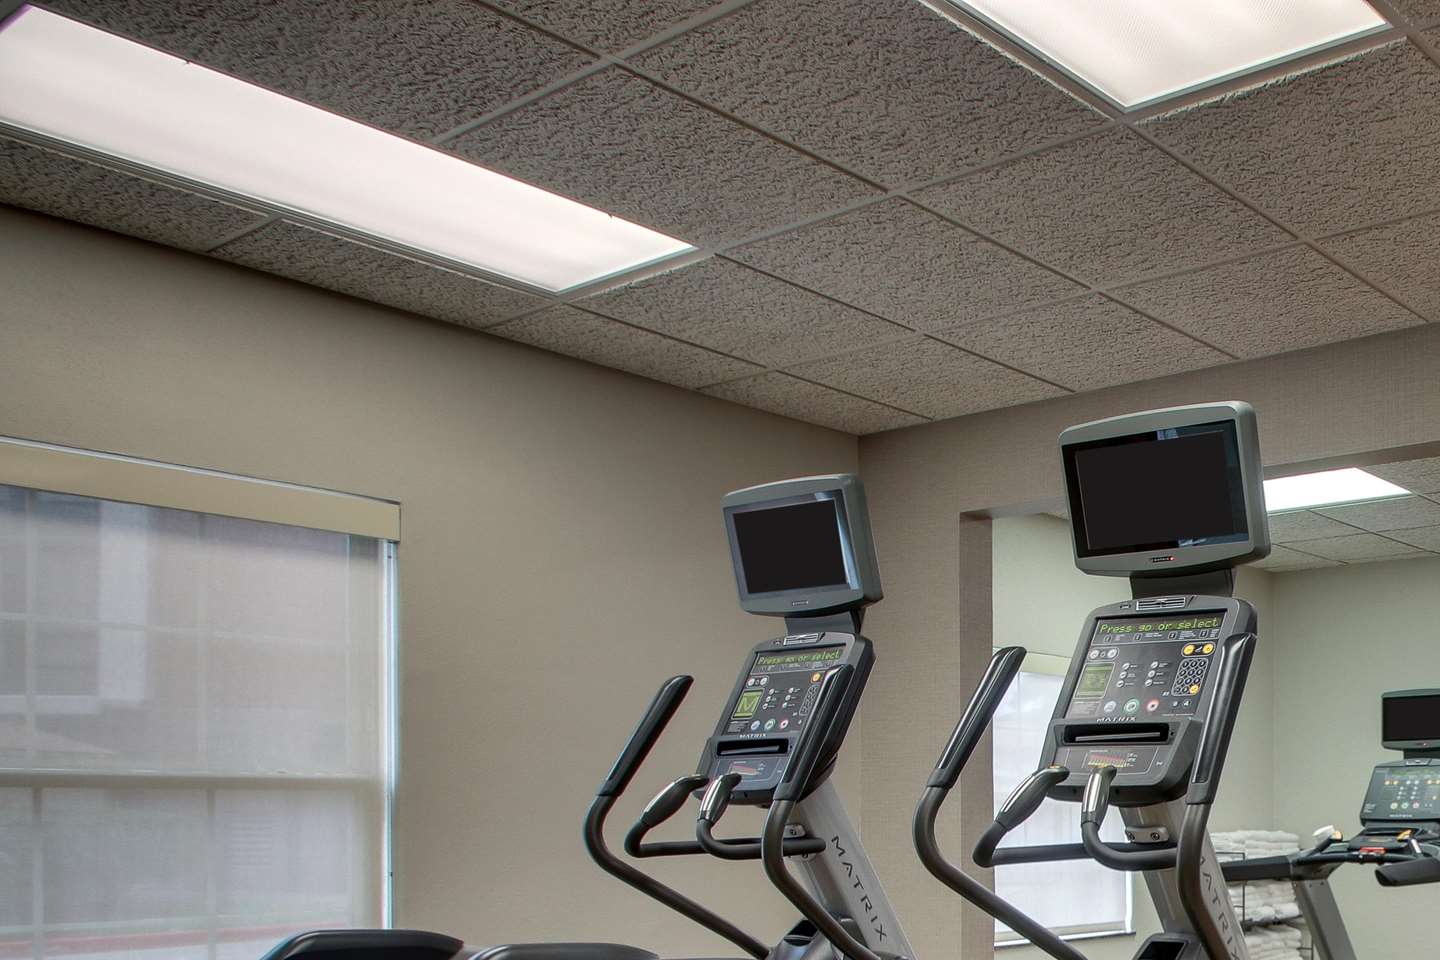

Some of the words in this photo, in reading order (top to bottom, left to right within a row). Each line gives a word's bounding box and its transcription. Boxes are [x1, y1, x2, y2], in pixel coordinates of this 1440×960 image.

[1099, 624, 1133, 634] Press
[1179, 617, 1219, 630] select
[831, 835, 888, 943] MATRIX
